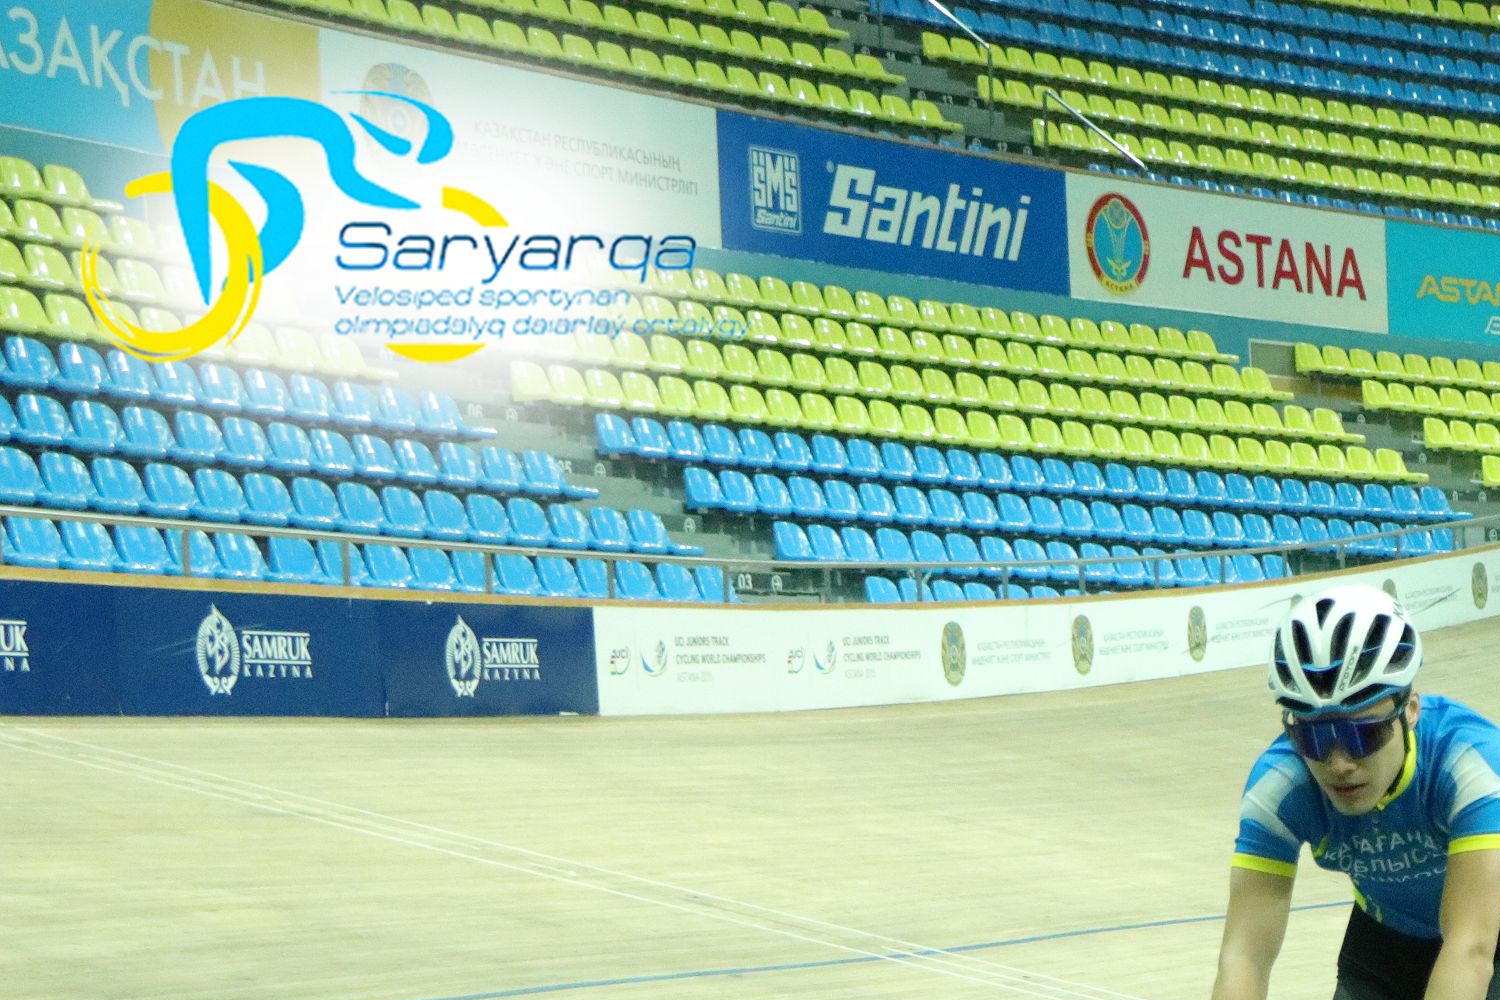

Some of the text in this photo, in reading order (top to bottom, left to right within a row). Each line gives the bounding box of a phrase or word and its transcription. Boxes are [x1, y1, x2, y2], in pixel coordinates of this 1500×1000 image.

[0, 7, 265, 107] ЗАҚСТАН
[823, 164, 1031, 262] Santini
[1183, 226, 1367, 301] ASTANA
[738, 573, 753, 590] 03
[242, 634, 312, 661] SAMRUK
[482, 641, 539, 666] SAMRUK
[242, 663, 313, 679] KAZYNA
[483, 667, 541, 681] KAZYNA
